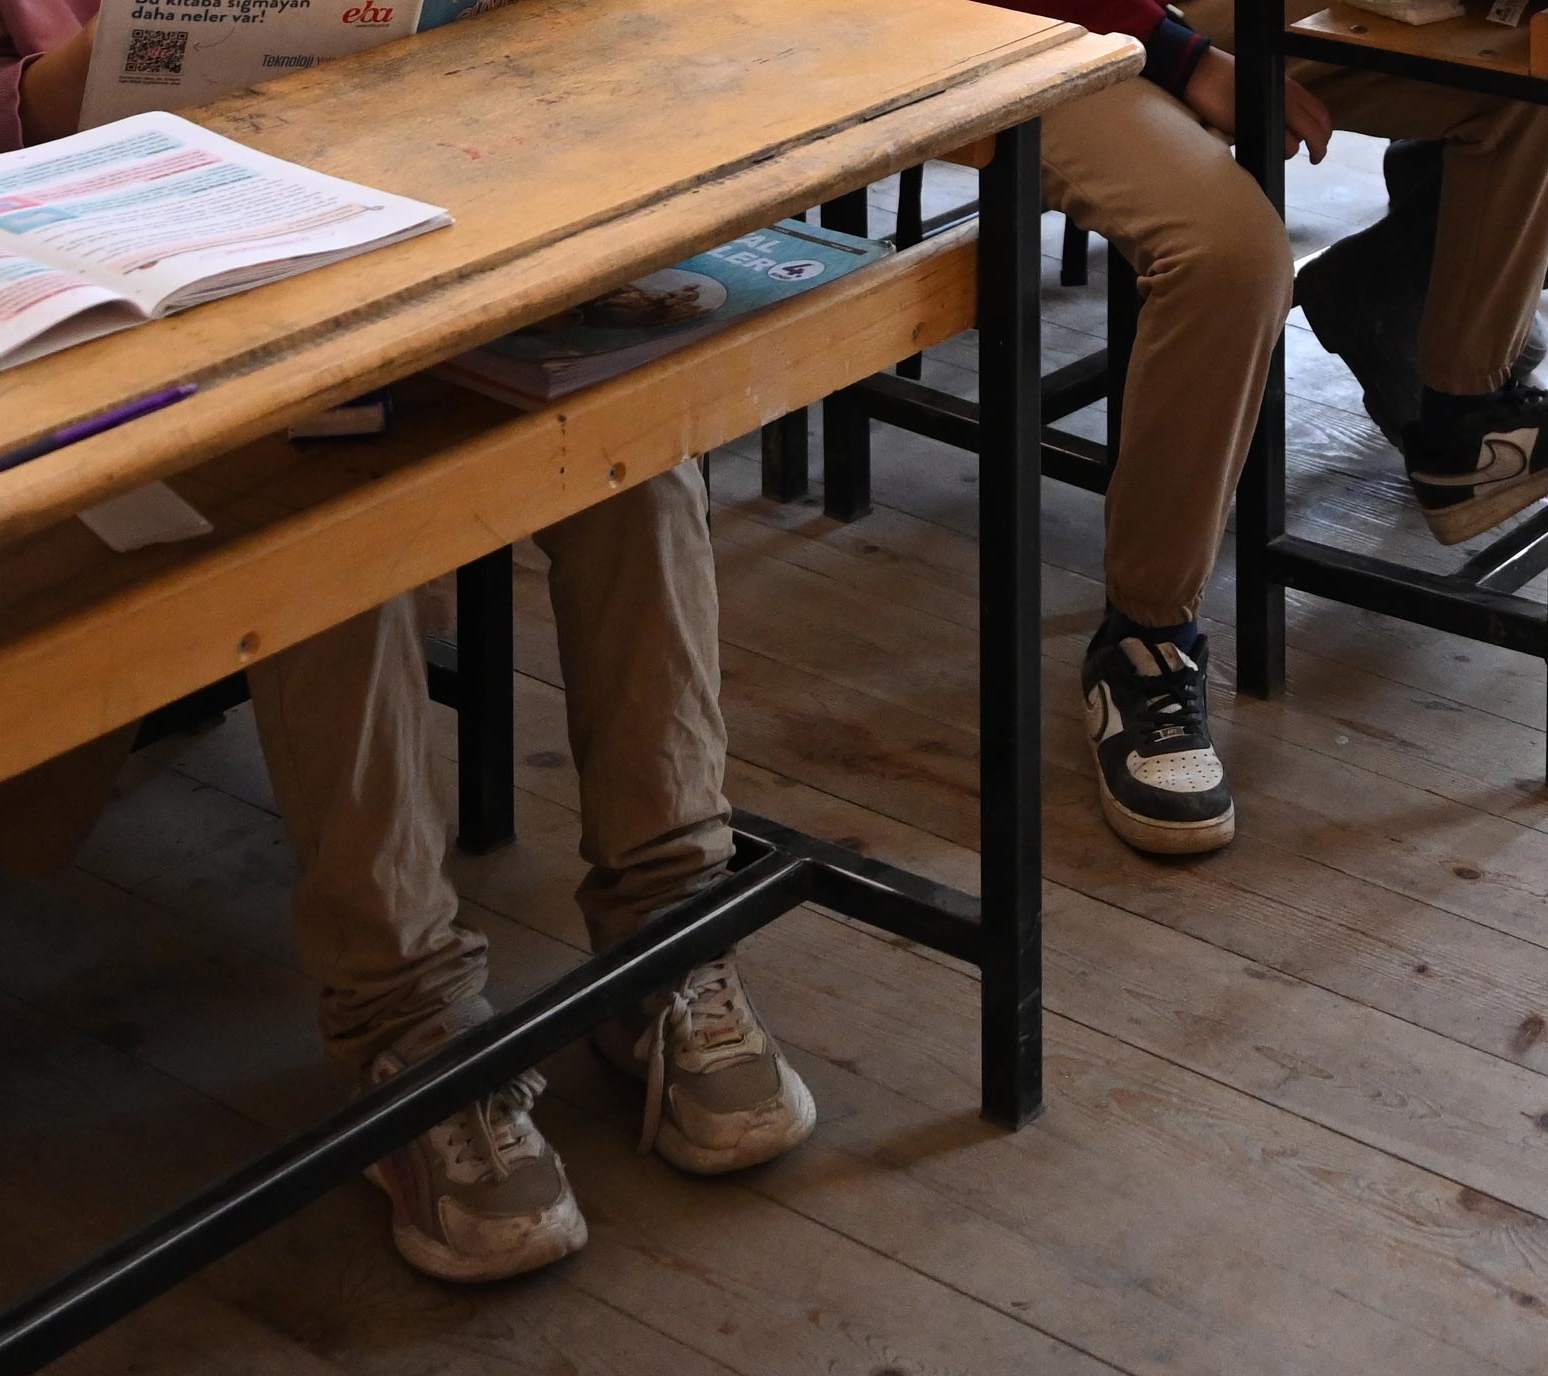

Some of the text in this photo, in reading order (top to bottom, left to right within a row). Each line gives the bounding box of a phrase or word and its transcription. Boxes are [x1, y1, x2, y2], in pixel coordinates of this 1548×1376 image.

[131, 6, 266, 24] daha neler var!
[341, 0, 394, 24] eba
[261, 53, 315, 69] Teknoloji
